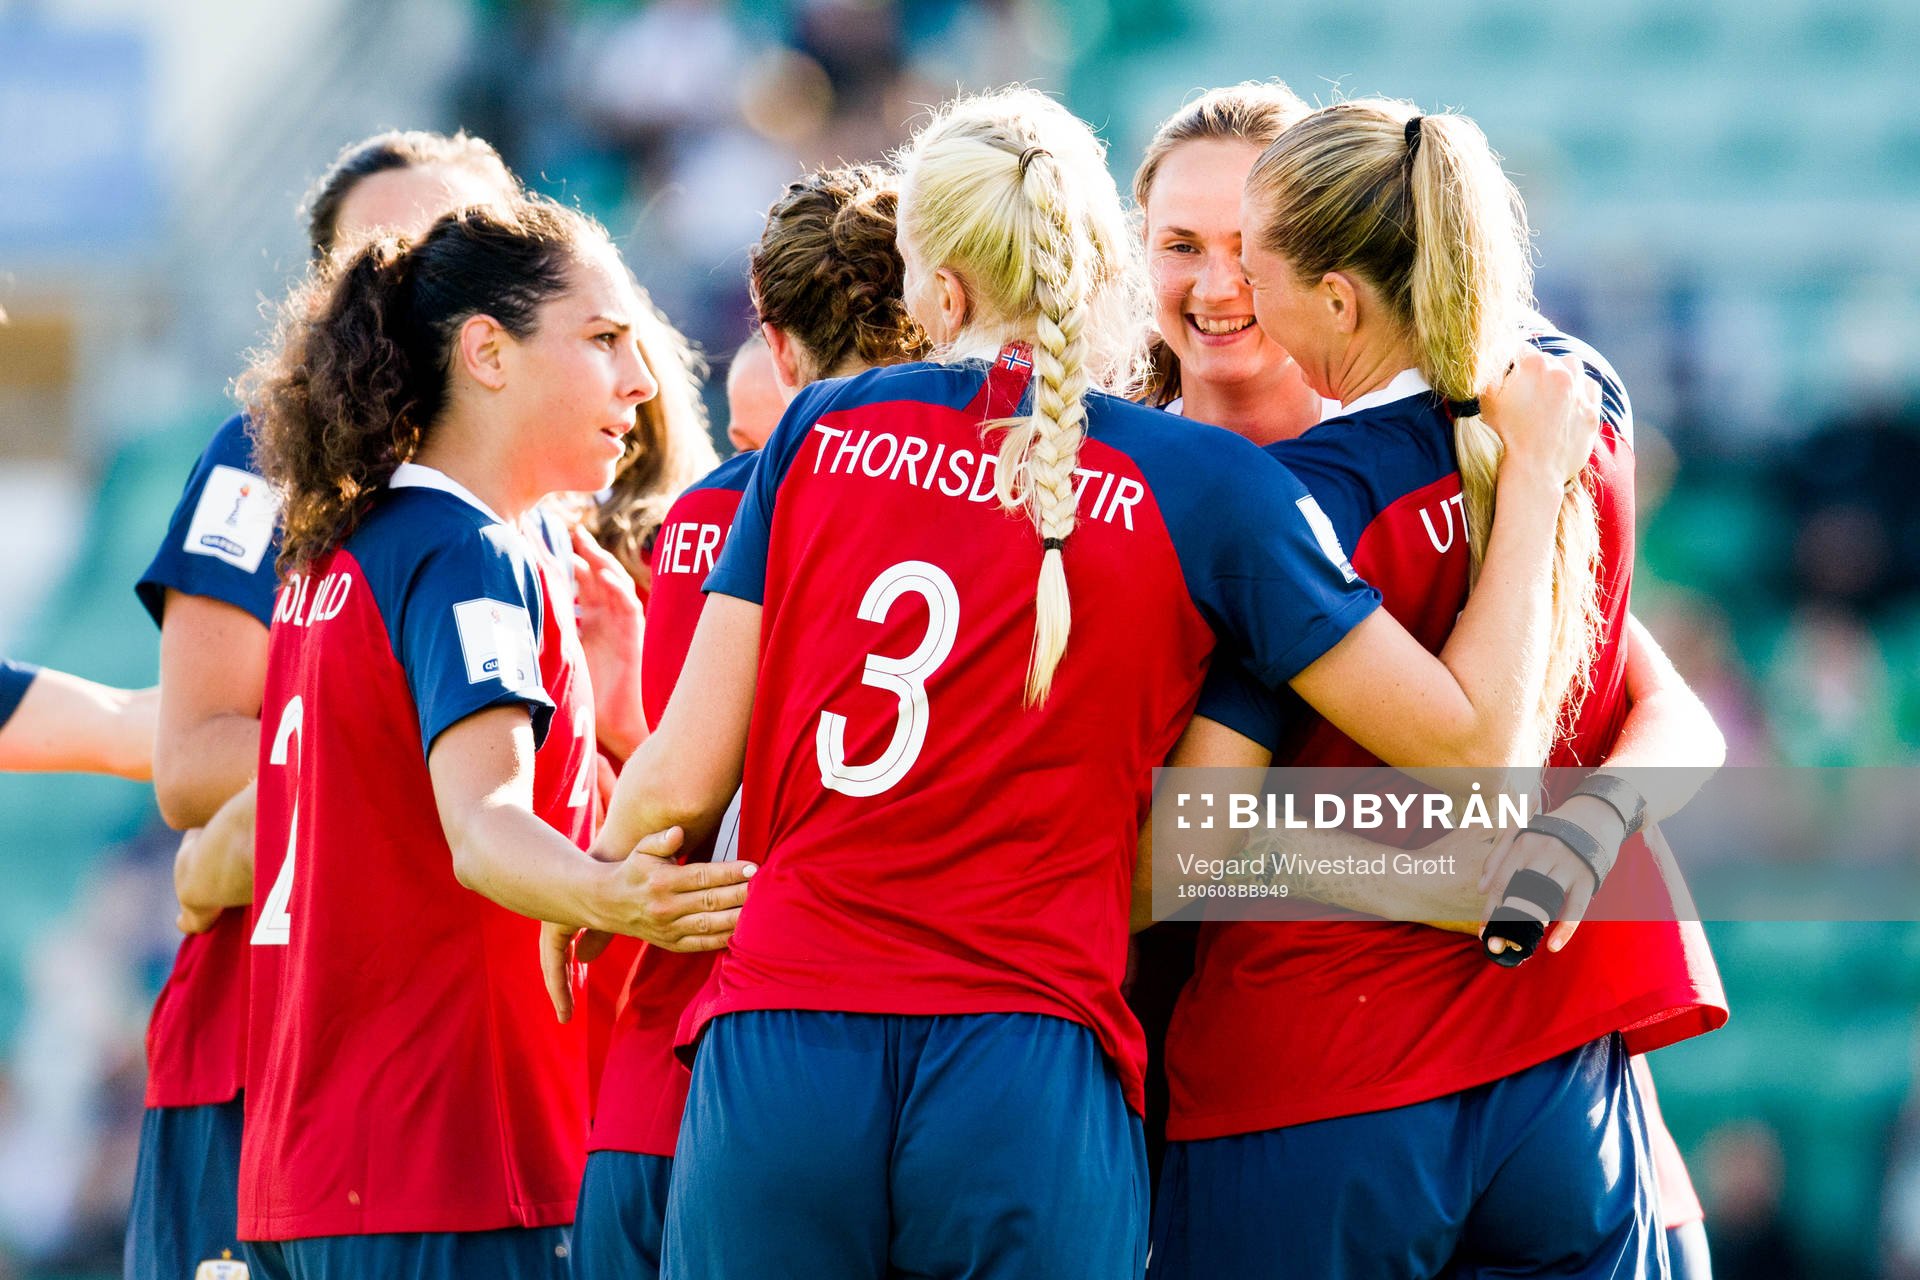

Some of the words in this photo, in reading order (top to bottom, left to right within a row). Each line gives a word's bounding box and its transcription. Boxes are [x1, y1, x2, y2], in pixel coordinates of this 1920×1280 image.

[657, 522, 732, 576] HER
[567, 705, 593, 808] 2
[816, 560, 960, 797] 3
[249, 695, 304, 944] 2
